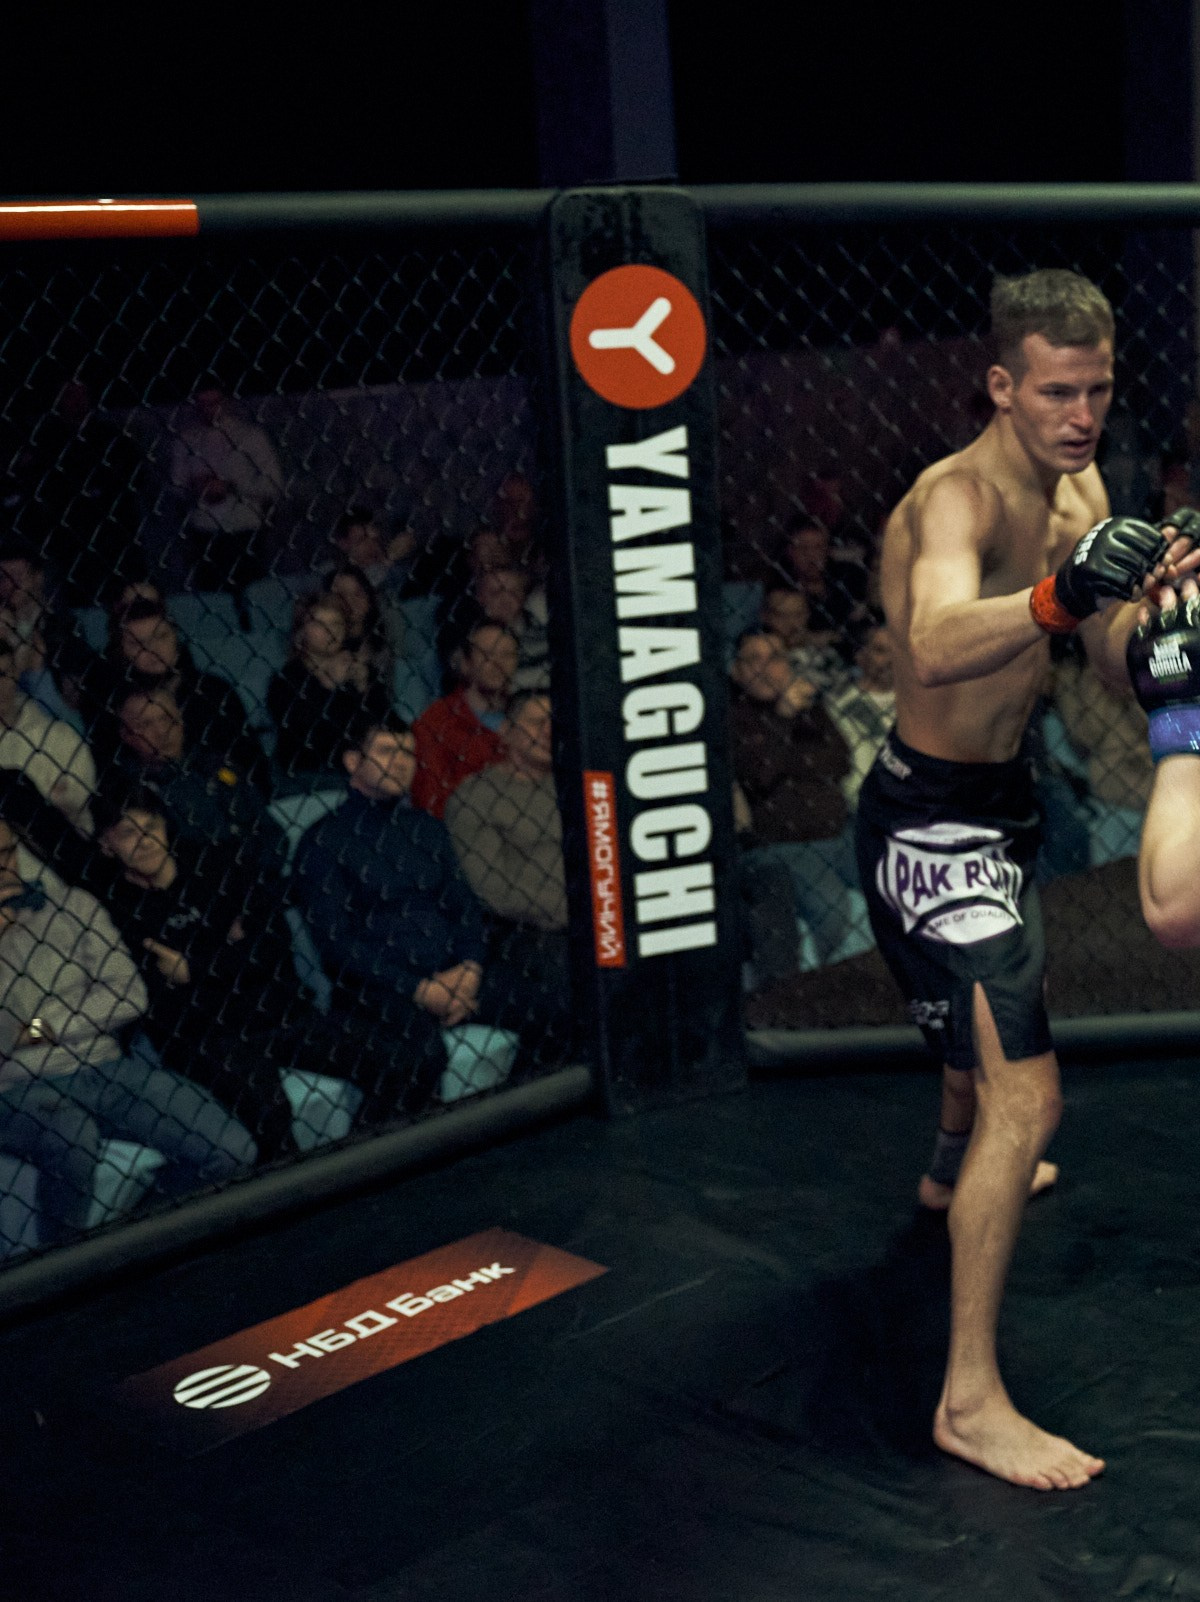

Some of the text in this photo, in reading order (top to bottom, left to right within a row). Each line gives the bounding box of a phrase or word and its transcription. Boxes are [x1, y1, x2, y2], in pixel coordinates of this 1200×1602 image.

[605, 425, 718, 959] YAMAGUCHI
[268, 1262, 517, 1369] НБД Банк
